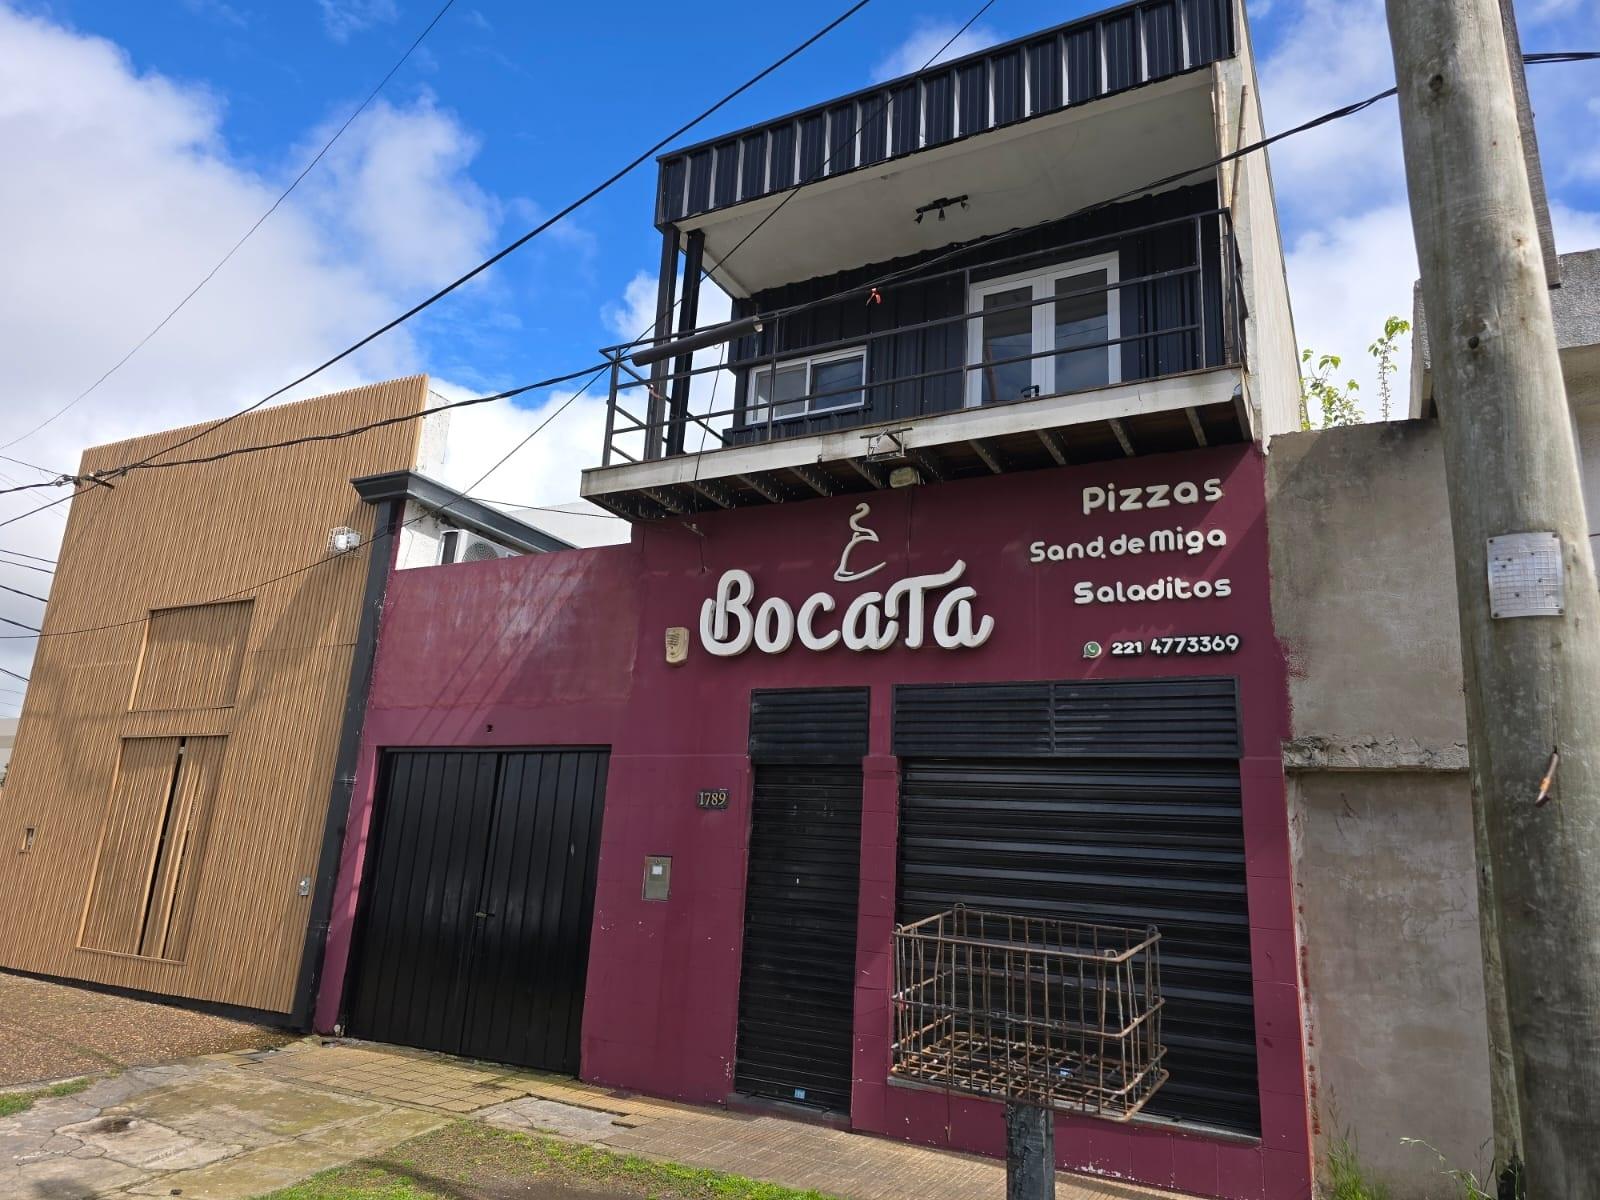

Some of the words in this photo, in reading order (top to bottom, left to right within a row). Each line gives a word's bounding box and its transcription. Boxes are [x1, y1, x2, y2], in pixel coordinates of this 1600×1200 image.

[1082, 478, 1224, 516] Pizzas
[1109, 534, 1145, 556] de
[1149, 526, 1227, 555] Miga
[1073, 576, 1232, 604] Saladitos
[1111, 641, 1143, 654] 221
[1150, 635, 1240, 654] 4773369
[699, 791, 727, 806] 1789
